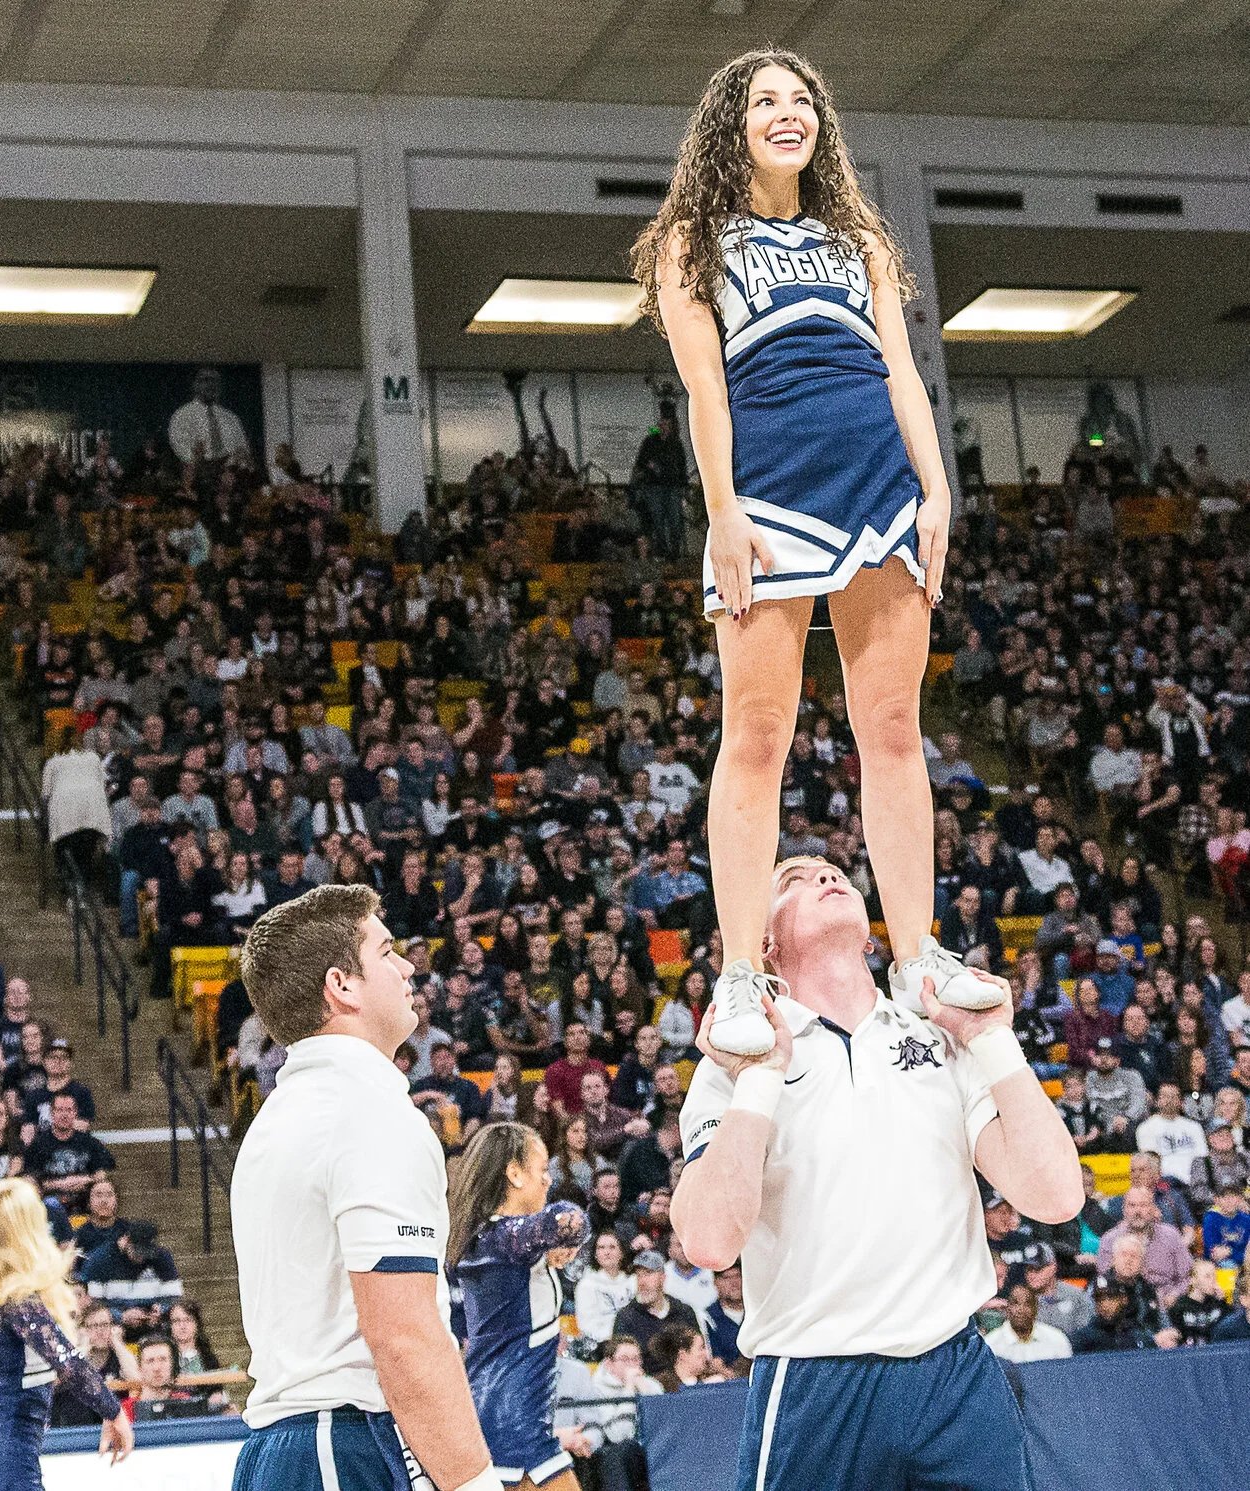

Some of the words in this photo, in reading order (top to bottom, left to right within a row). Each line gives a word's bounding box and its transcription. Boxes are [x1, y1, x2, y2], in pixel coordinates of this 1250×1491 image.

[740, 241, 869, 299] AGGIES
[383, 374, 409, 399] M
[397, 1225, 419, 1237] UTAH
